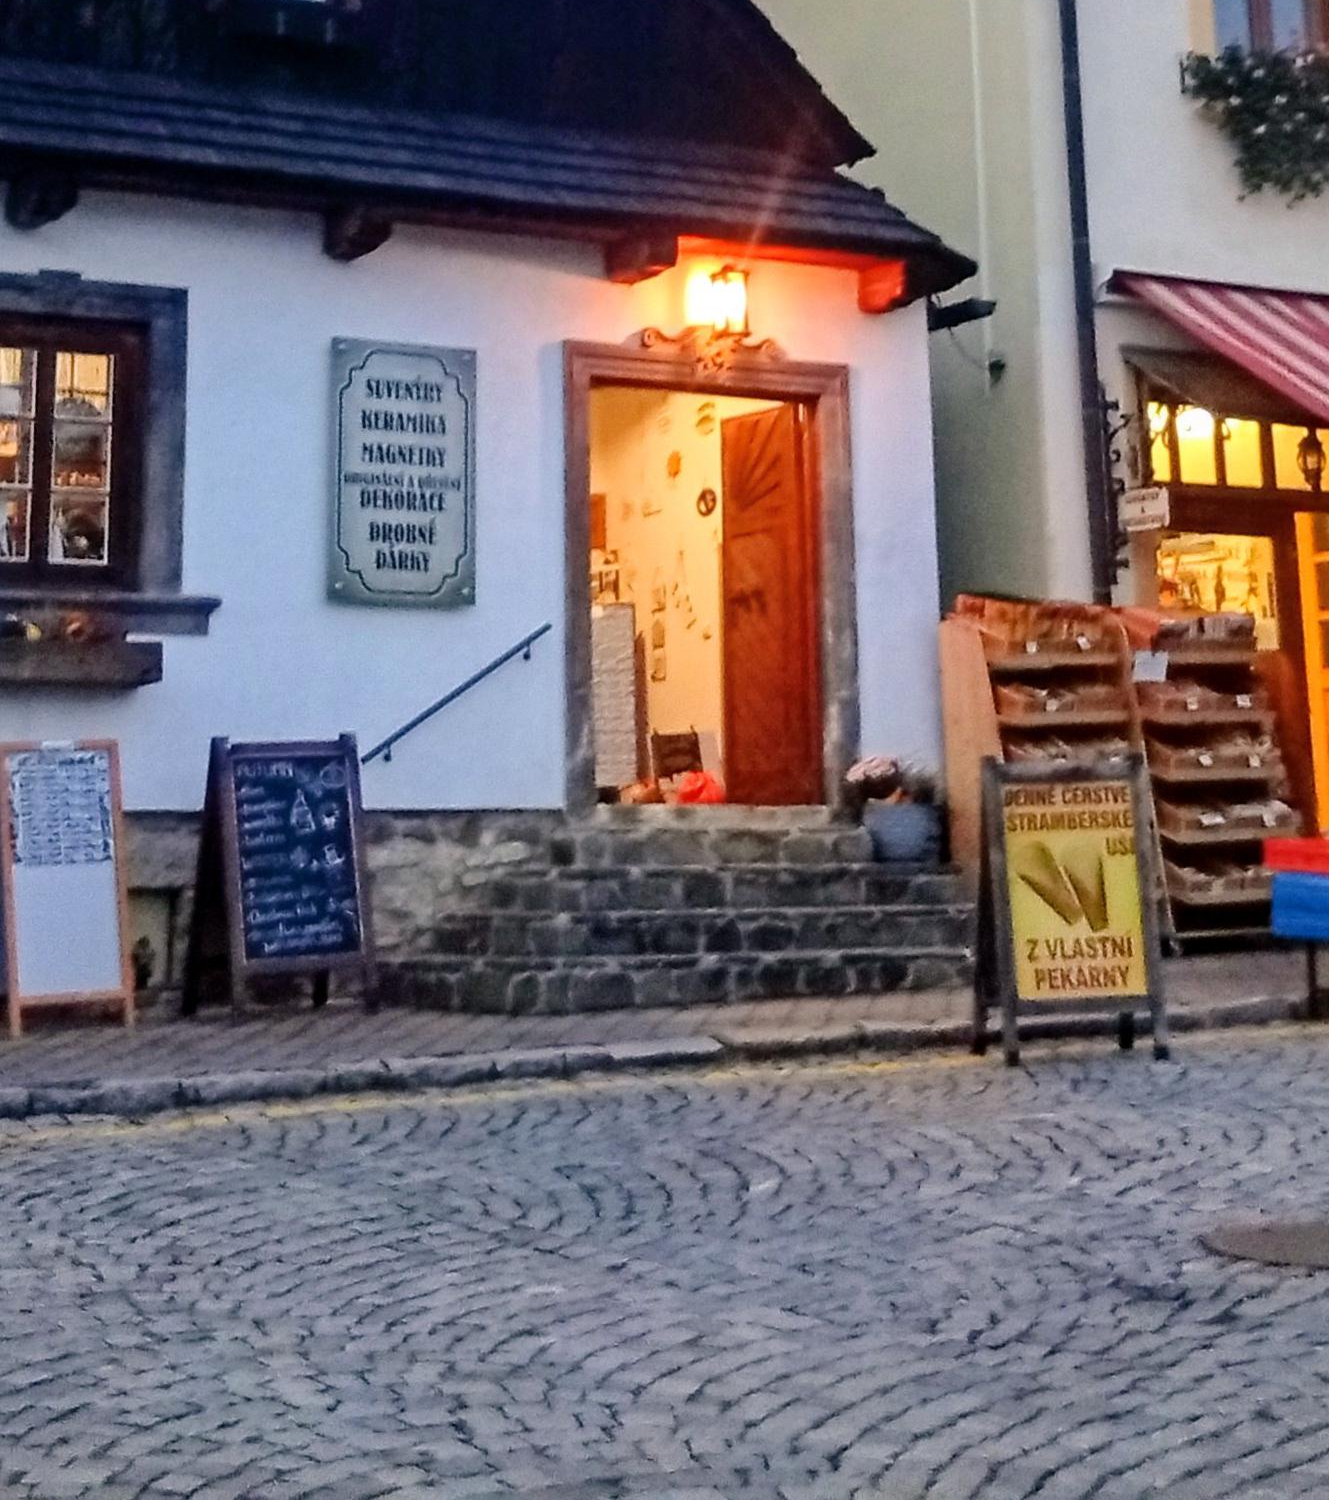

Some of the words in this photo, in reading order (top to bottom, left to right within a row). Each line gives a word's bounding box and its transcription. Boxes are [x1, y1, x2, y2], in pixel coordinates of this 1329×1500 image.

[361, 409, 446, 434] KERAMIKA
[359, 488, 447, 513] DEKORACE
[1026, 938, 1039, 963] Z
